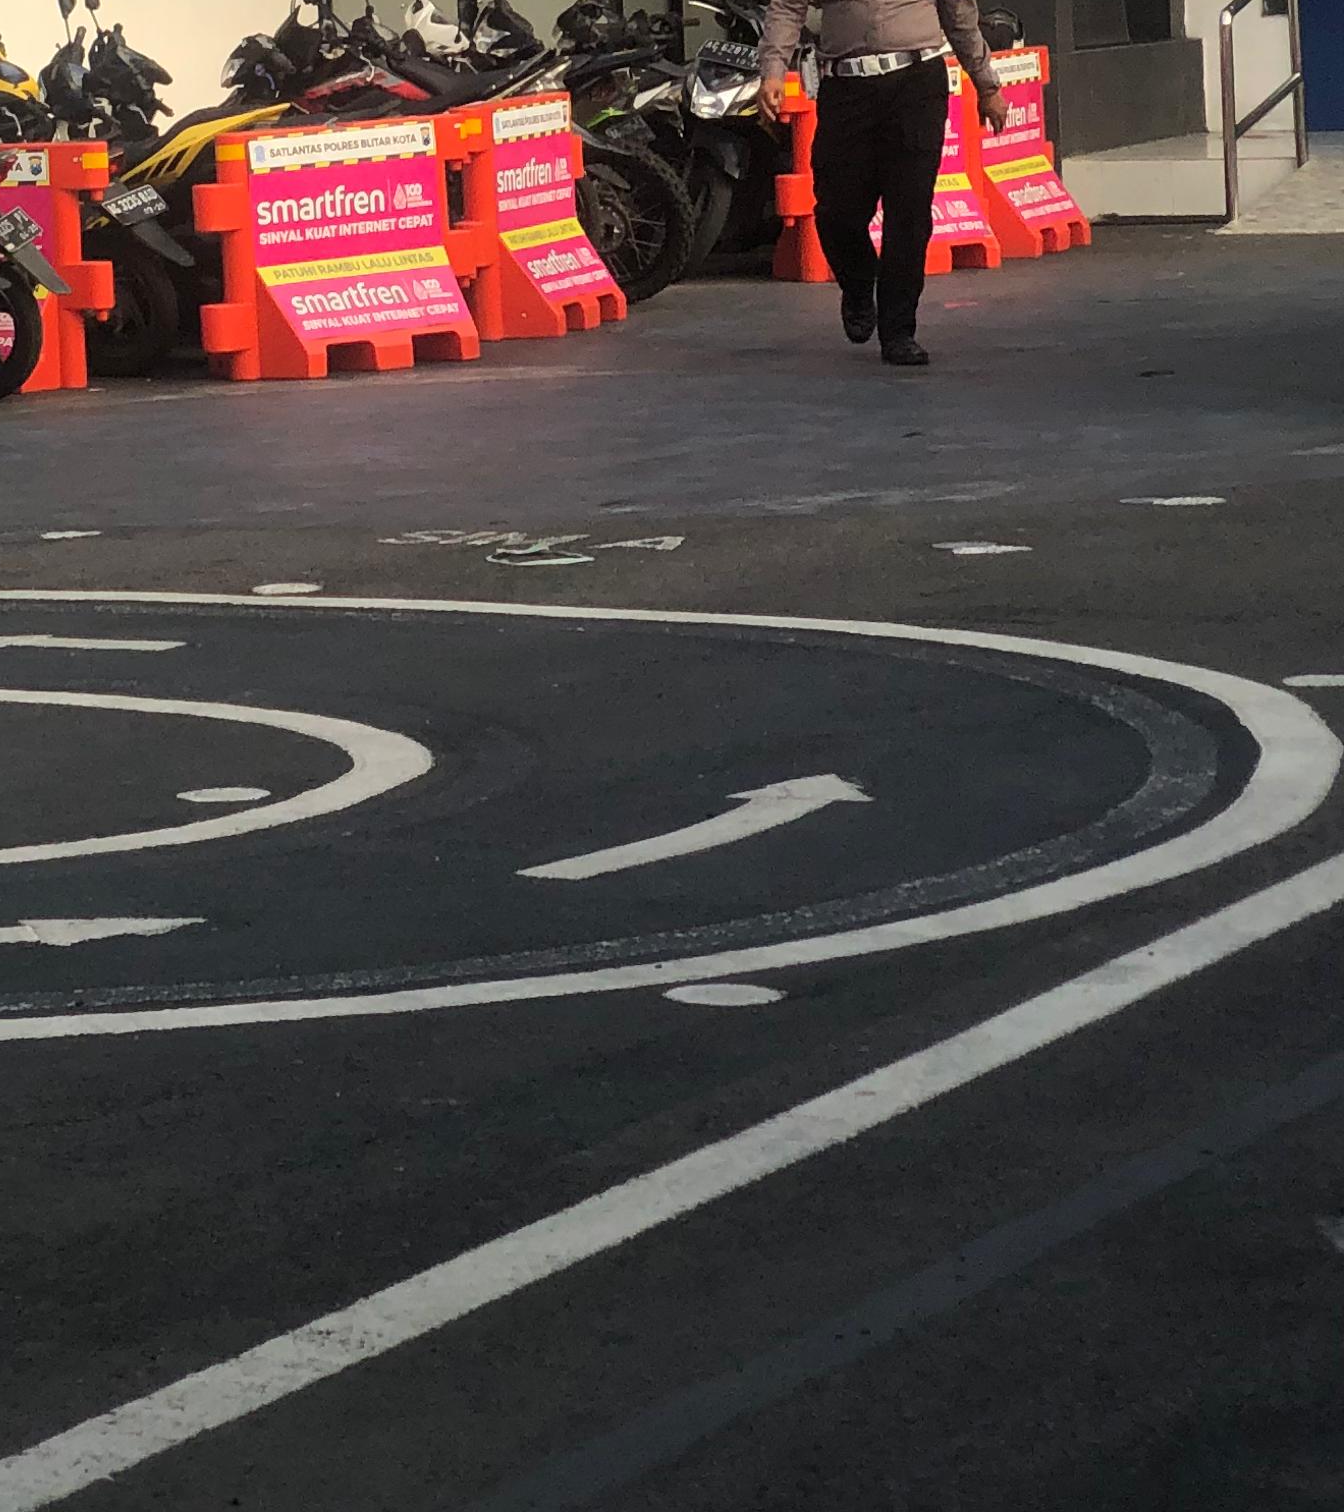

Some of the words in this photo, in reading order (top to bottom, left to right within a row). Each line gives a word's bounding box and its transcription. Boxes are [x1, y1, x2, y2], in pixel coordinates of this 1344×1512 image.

[269, 144, 322, 158] SATLANTAS
[324, 140, 360, 154] POLRES
[361, 137, 391, 150] BLITAR
[392, 134, 417, 147] KOTA
[497, 157, 552, 193] smartfren
[256, 185, 385, 225] smartfren
[259, 230, 303, 245] SINYAL
[304, 225, 338, 240] KUAT
[339, 218, 397, 236] INTERNET
[398, 214, 434, 229] CEPAT
[273, 268, 316, 280] PATUHI
[318, 260, 361, 274] RAMBU
[362, 257, 392, 270] LALU
[393, 252, 434, 266] LINTAS
[291, 282, 409, 315] smartfren
[302, 317, 342, 331] SINYAL
[342, 313, 372, 327] KUAT
[373, 308, 425, 323] INTERNET
[426, 303, 459, 316] CEPAT
